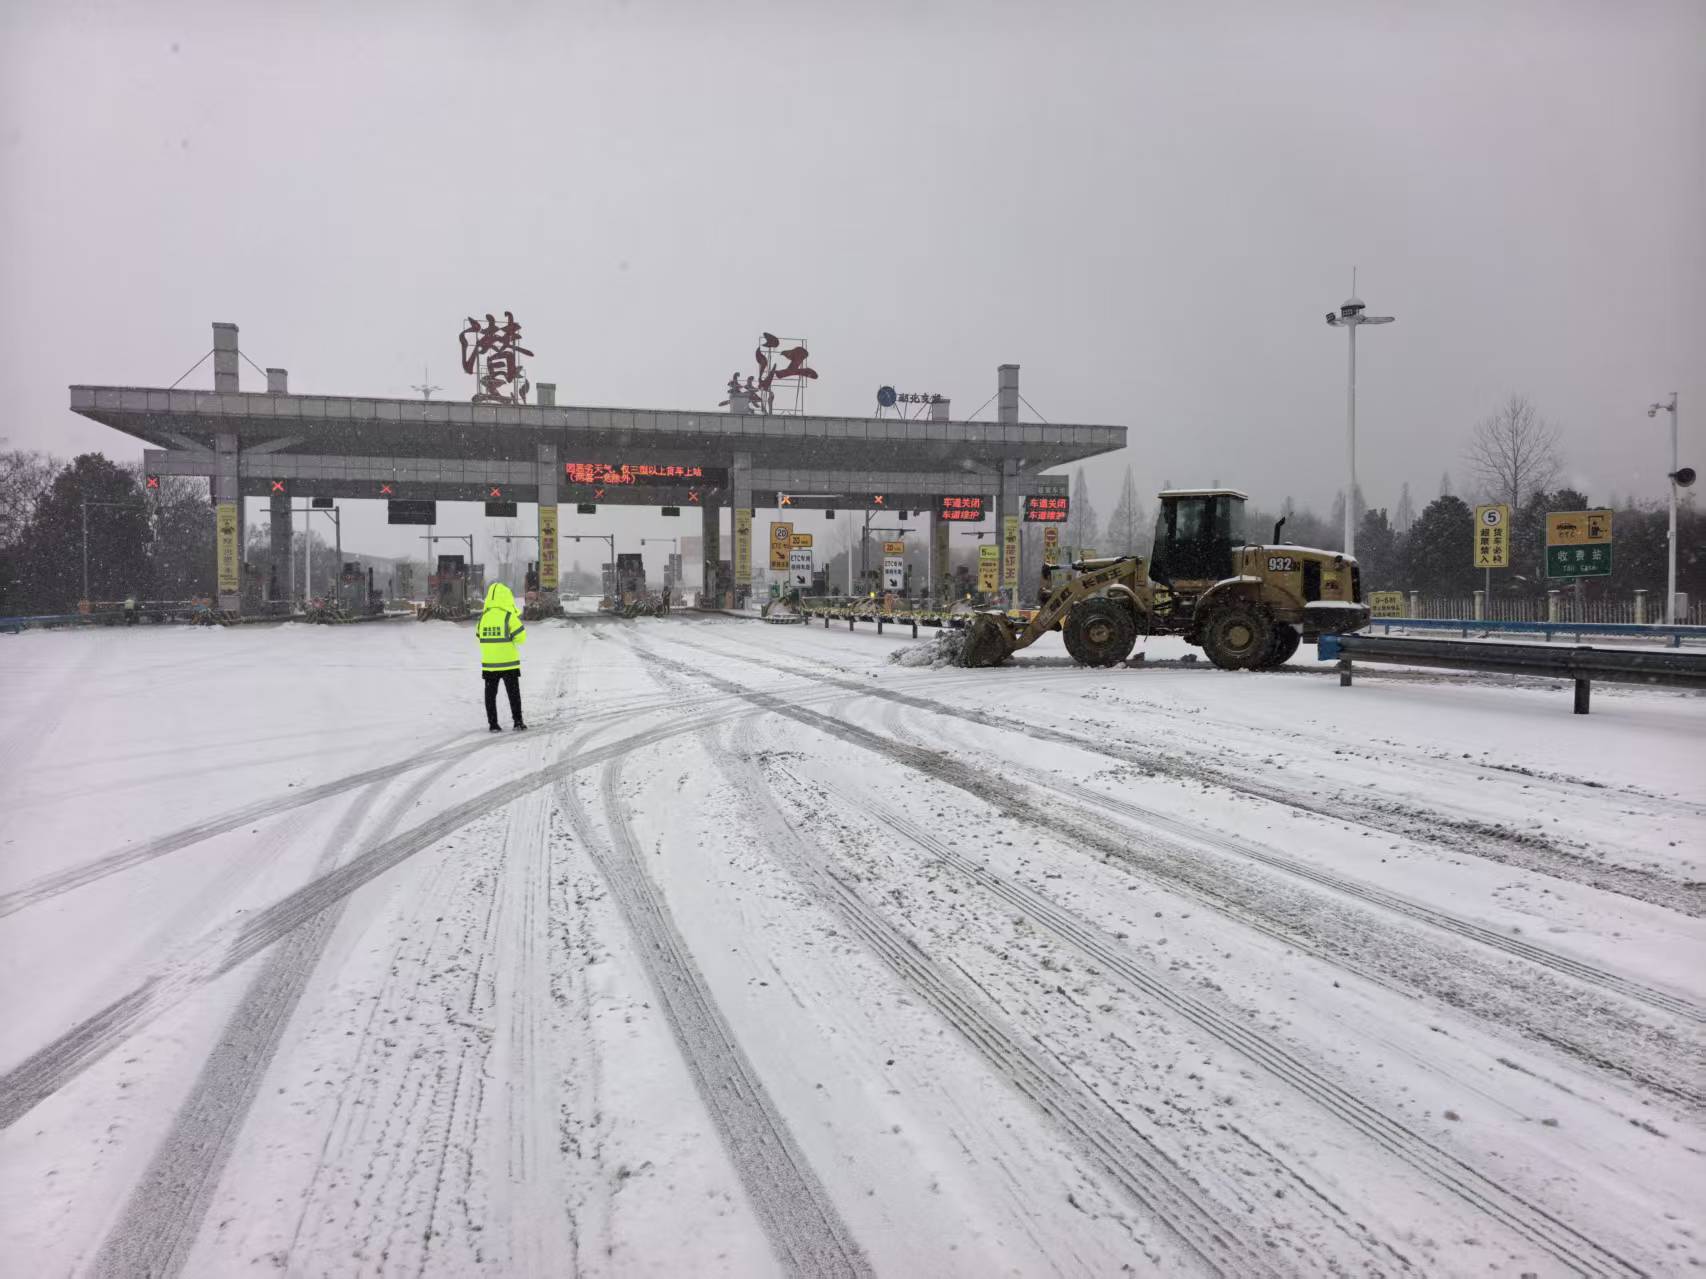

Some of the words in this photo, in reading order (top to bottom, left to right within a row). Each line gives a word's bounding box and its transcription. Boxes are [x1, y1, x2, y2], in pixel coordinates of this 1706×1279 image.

[459, 311, 534, 382] 潜
[756, 332, 818, 394] 江
[943, 497, 980, 508] 车道关闭
[1030, 498, 1066, 509] 车道关闭
[943, 510, 980, 520] 车道维护
[1028, 510, 1066, 520] 车道维护
[1487, 511, 1497, 523] 5
[777, 529, 786, 537] 20
[792, 536, 800, 544] 20
[1480, 528, 1490, 563] 超限禁入
[1493, 527, 1503, 563] 货车必检
[1557, 548, 1602, 562] 收费站
[1268, 557, 1292, 571] 932
